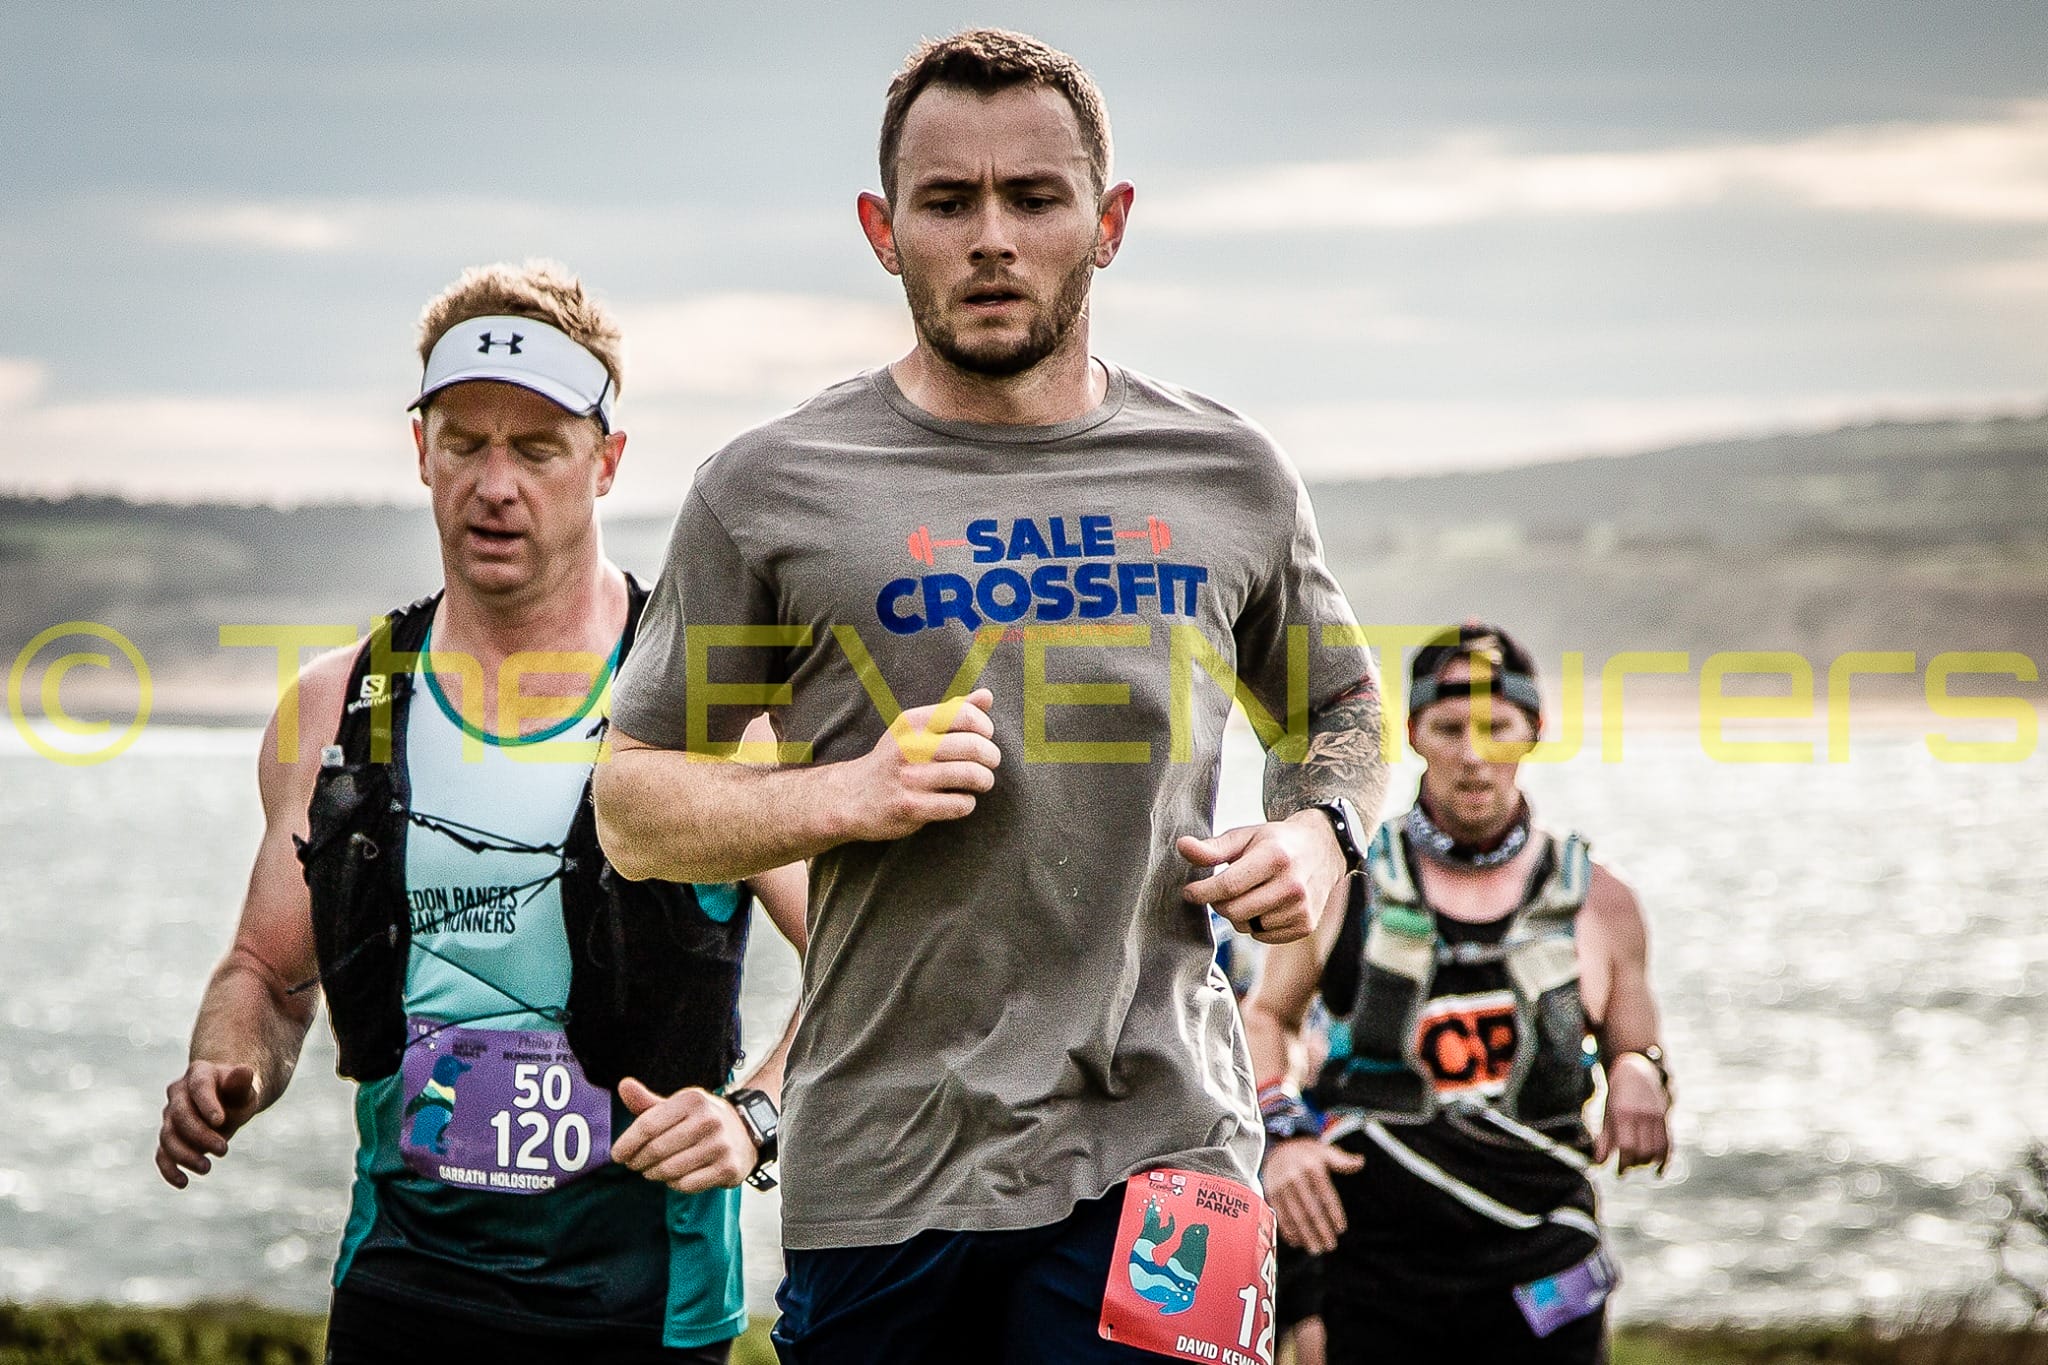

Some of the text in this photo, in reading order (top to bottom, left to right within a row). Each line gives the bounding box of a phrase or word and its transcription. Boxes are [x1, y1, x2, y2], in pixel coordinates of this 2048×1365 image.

[966, 515, 1116, 563] SALE
[876, 563, 1207, 635] CROSSFIT
[452, 885, 518, 911] RANGES
[443, 911, 517, 934] RUNNERS
[512, 1063, 572, 1111] 50
[490, 1110, 592, 1172] 120
[1195, 1198, 1240, 1219] PARKS
[1197, 1188, 1250, 1213] NATURE
[1176, 1335, 1218, 1360] DAVID
